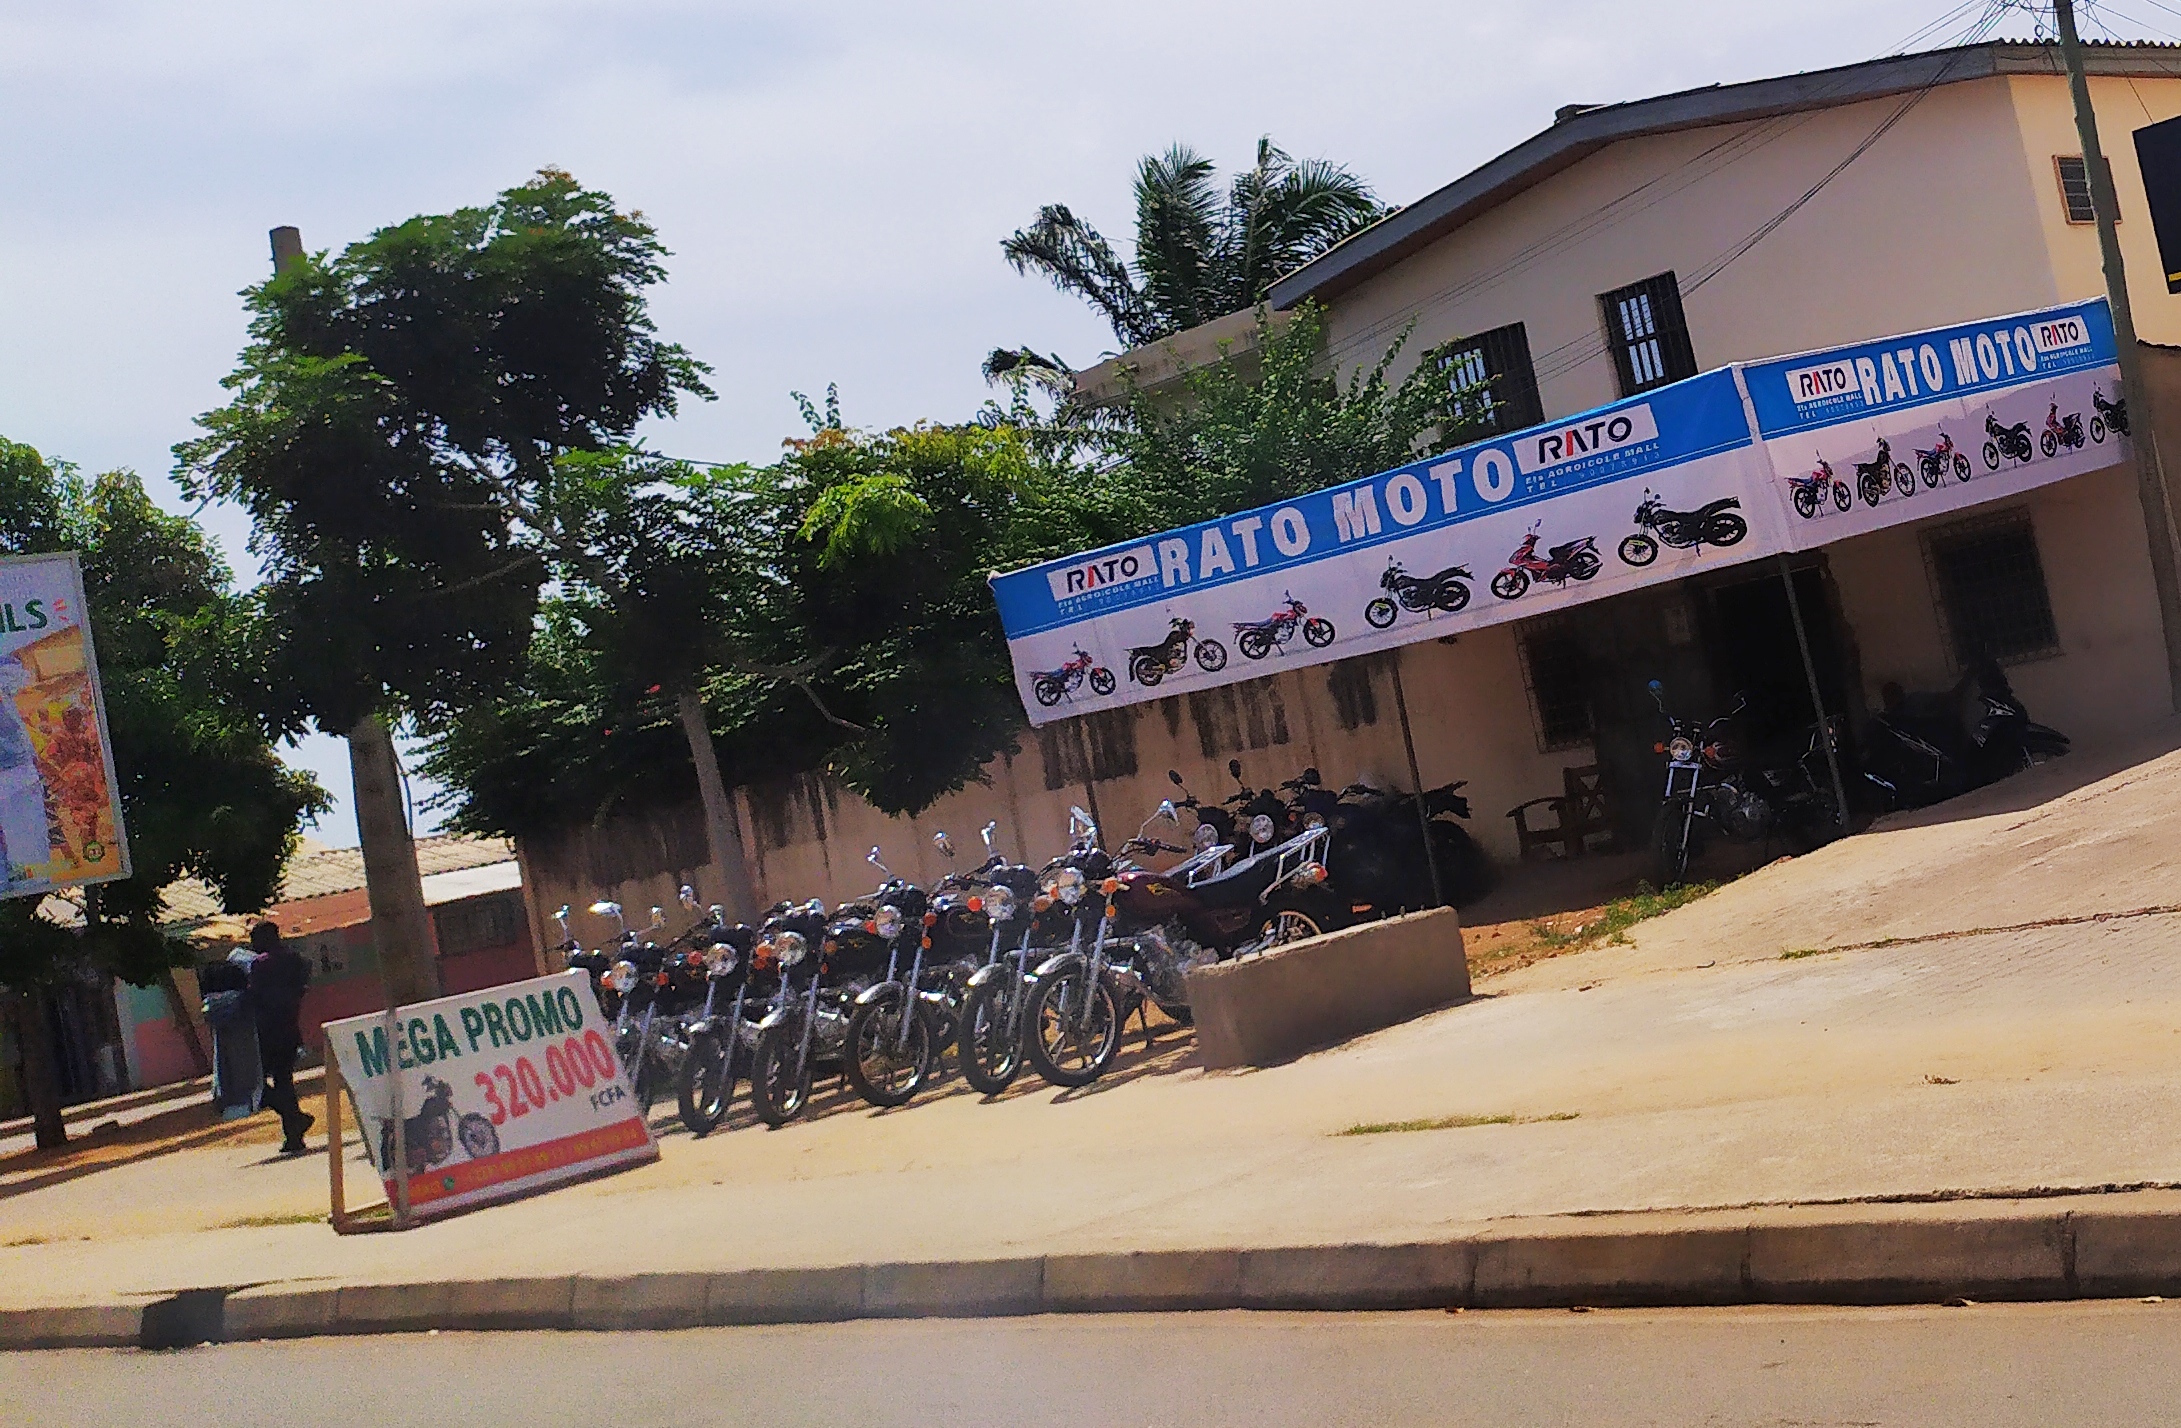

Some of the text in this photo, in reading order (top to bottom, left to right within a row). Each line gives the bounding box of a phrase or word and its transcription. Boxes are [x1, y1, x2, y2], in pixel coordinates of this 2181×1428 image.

[2041, 322, 2078, 347] RATO
[1799, 367, 1846, 397] RATO
[1856, 326, 2036, 405] RATO MOTO
[1538, 417, 1632, 464] RATO
[1625, 442, 1659, 457] MALL
[1527, 480, 1557, 493] TEL
[1158, 449, 1514, 588] RATO MOTO
[1067, 556, 1139, 593] RATO
[354, 986, 583, 1078] MEGA PROMO
[474, 1029, 615, 1125] 320.000
